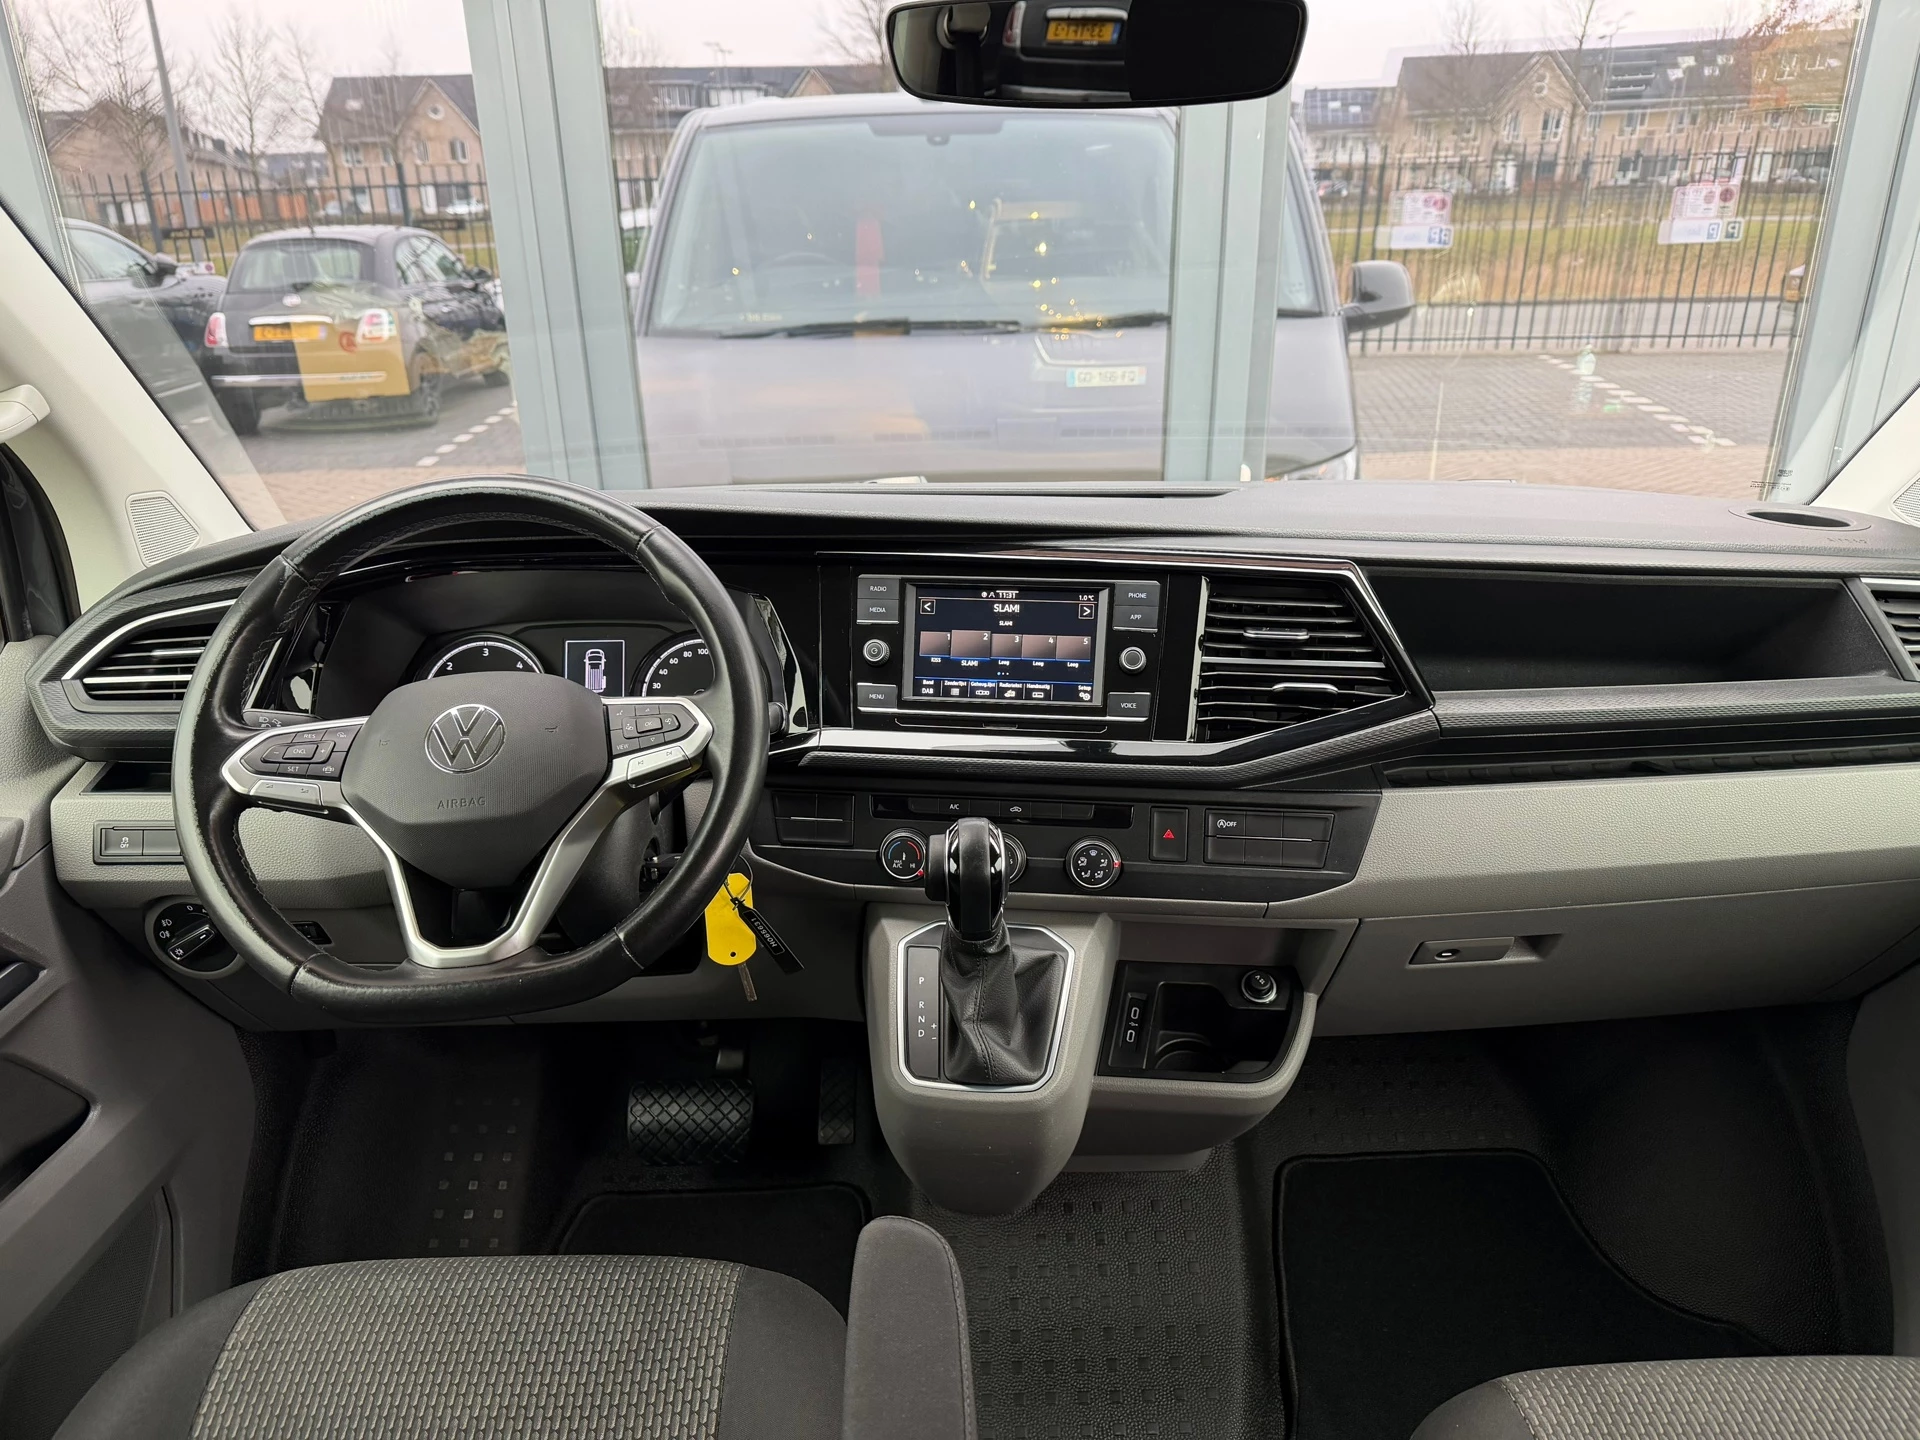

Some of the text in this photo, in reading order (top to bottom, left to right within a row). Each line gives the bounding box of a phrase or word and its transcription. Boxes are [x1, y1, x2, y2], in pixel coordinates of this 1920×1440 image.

[993, 603, 1020, 613] SLAM!
[983, 633, 989, 641] 2
[1014, 635, 1020, 643] 3
[482, 648, 489, 657] 3
[446, 662, 453, 671] 2
[516, 661, 523, 669] 4
[616, 743, 630, 751] VIEW
[437, 796, 487, 810] AIRBAG
[918, 976, 925, 985] P
[918, 1001, 925, 1009] R
[918, 1015, 925, 1023] N
[918, 1029, 925, 1038] D
